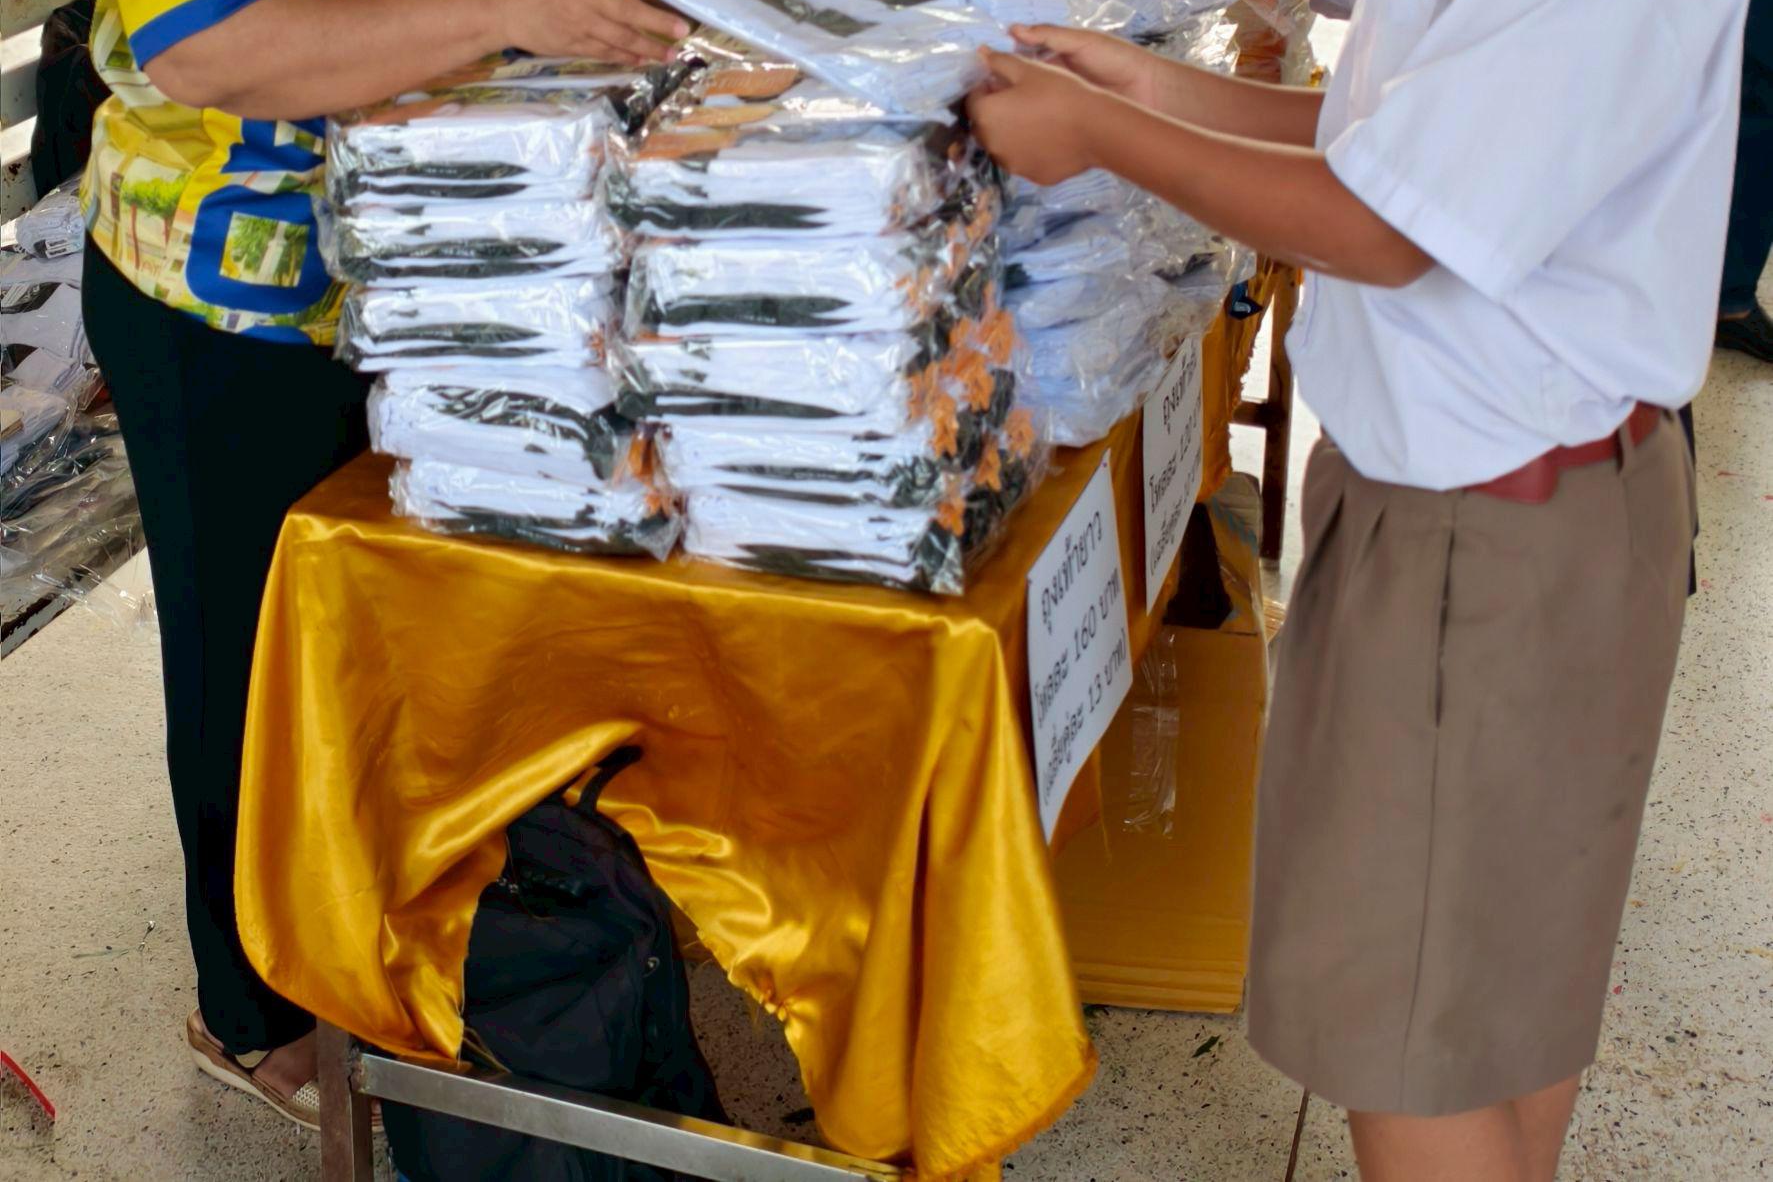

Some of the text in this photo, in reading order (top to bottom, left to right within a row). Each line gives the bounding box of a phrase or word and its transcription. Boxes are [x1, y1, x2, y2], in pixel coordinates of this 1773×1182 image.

[1041, 510, 1103, 635] ถุงเท้ายาว
[1034, 567, 1120, 730] โหลละ 160 บาท
[1088, 673, 1103, 713] 13
[1104, 626, 1127, 687] บาท)
